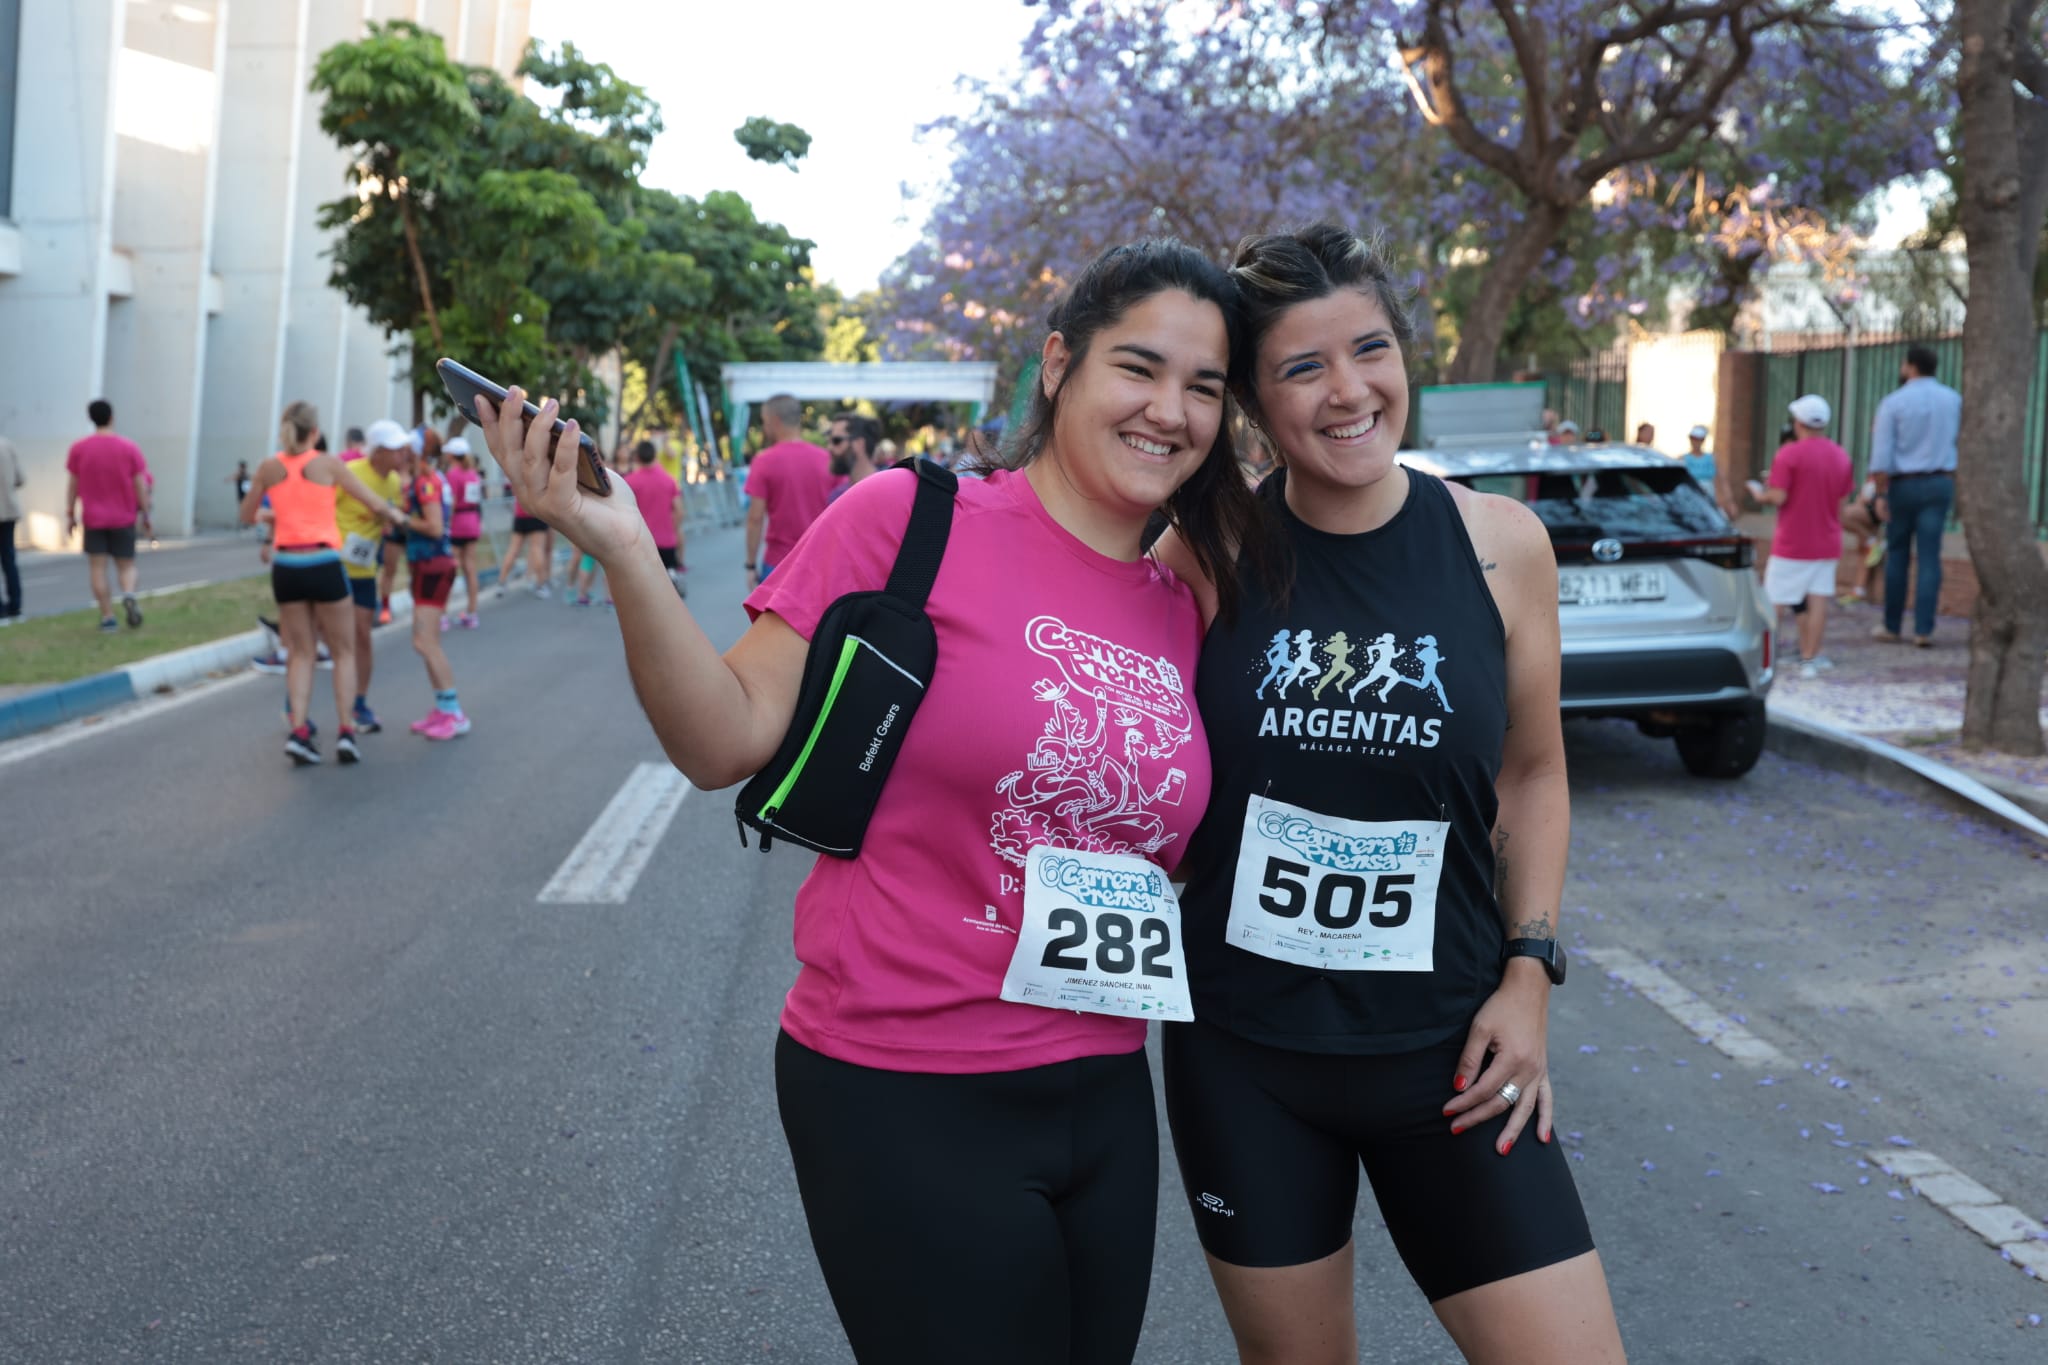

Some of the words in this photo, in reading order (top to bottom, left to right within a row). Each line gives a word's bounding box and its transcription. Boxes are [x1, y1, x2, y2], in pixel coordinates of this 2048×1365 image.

[1036, 622, 1163, 683] Carrera
[1068, 652, 1177, 707] Prensa
[876, 703, 900, 737] Gears
[1258, 706, 1443, 748] ARGENTAS
[1299, 741, 1353, 754] MÁLAGA
[1362, 746, 1397, 758] TEAM
[1285, 818, 1396, 855] Carrera
[1303, 844, 1401, 871] Prensa
[1061, 860, 1149, 893] Carrera
[1258, 855, 1416, 930] 505
[1077, 886, 1154, 912] Prensa
[1040, 907, 1174, 979] 282
[1298, 927, 1314, 936] REY
[1319, 931, 1362, 940] MACARENA
[1136, 983, 1152, 991] INMA
